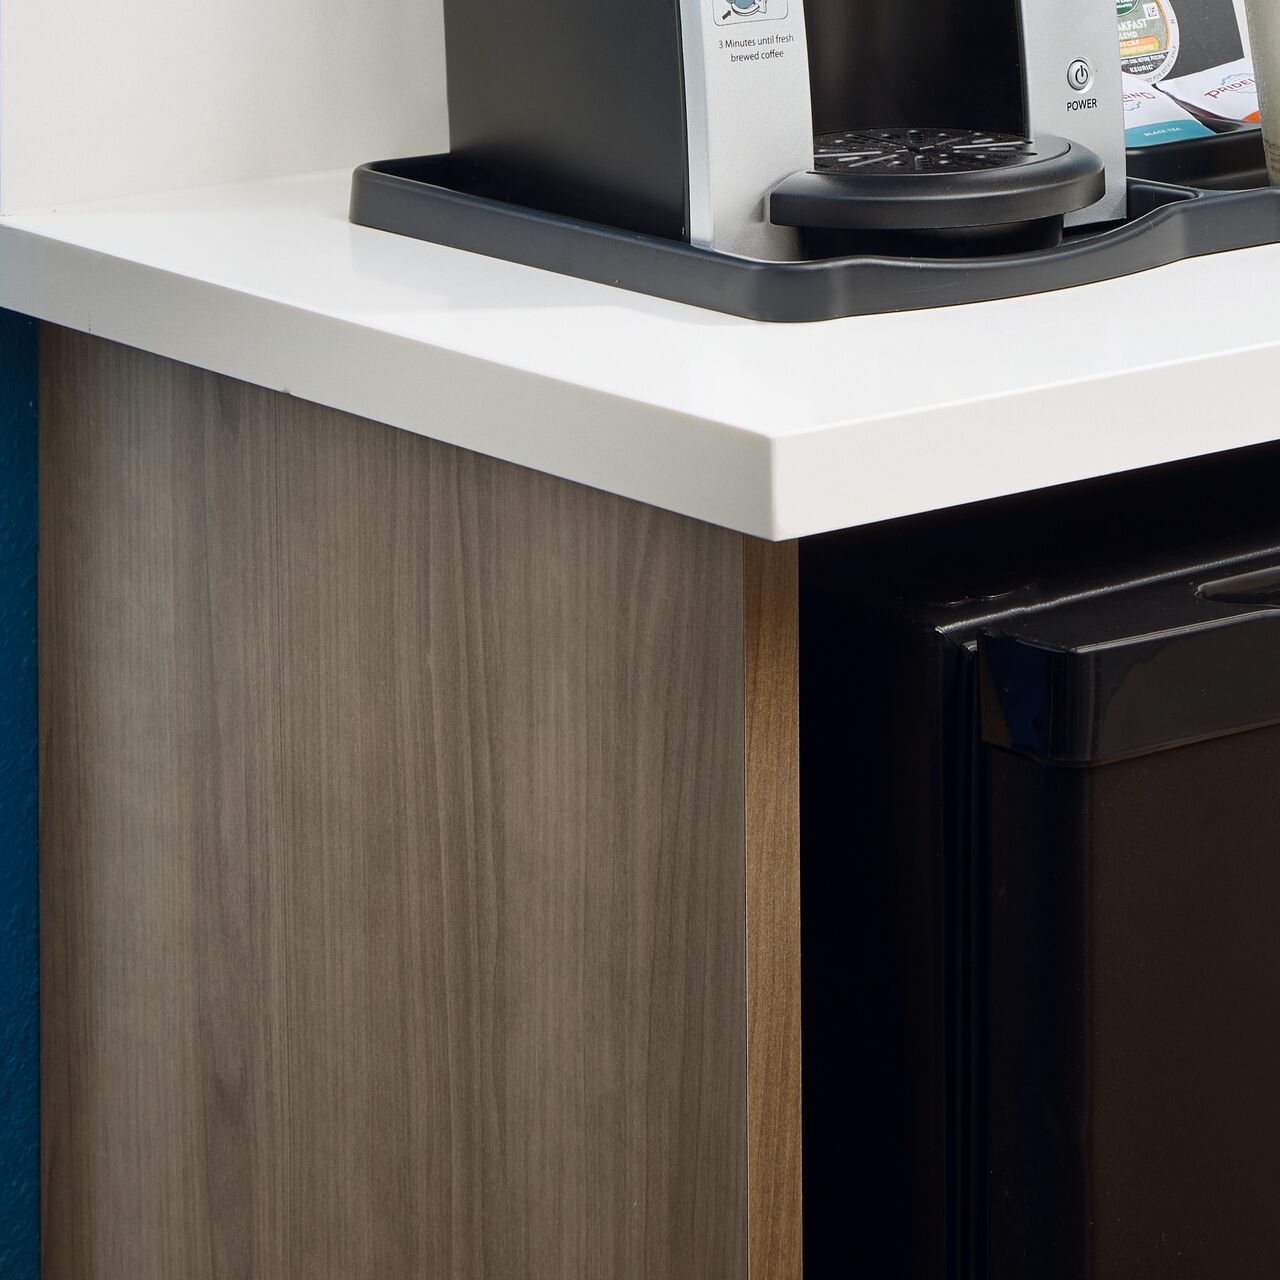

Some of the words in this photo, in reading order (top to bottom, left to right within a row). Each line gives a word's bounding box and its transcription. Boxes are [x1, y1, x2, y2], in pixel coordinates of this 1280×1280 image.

[1118, 18, 1147, 31] AKFAST
[719, 40, 724, 49] 3
[725, 39, 756, 48] Minutes
[757, 35, 775, 45] until
[775, 33, 794, 43] fresh
[731, 51, 760, 62] brewed
[761, 49, 784, 59] coffee
[1129, 64, 1153, 73] KEURIG
[1066, 98, 1098, 111] POWER
